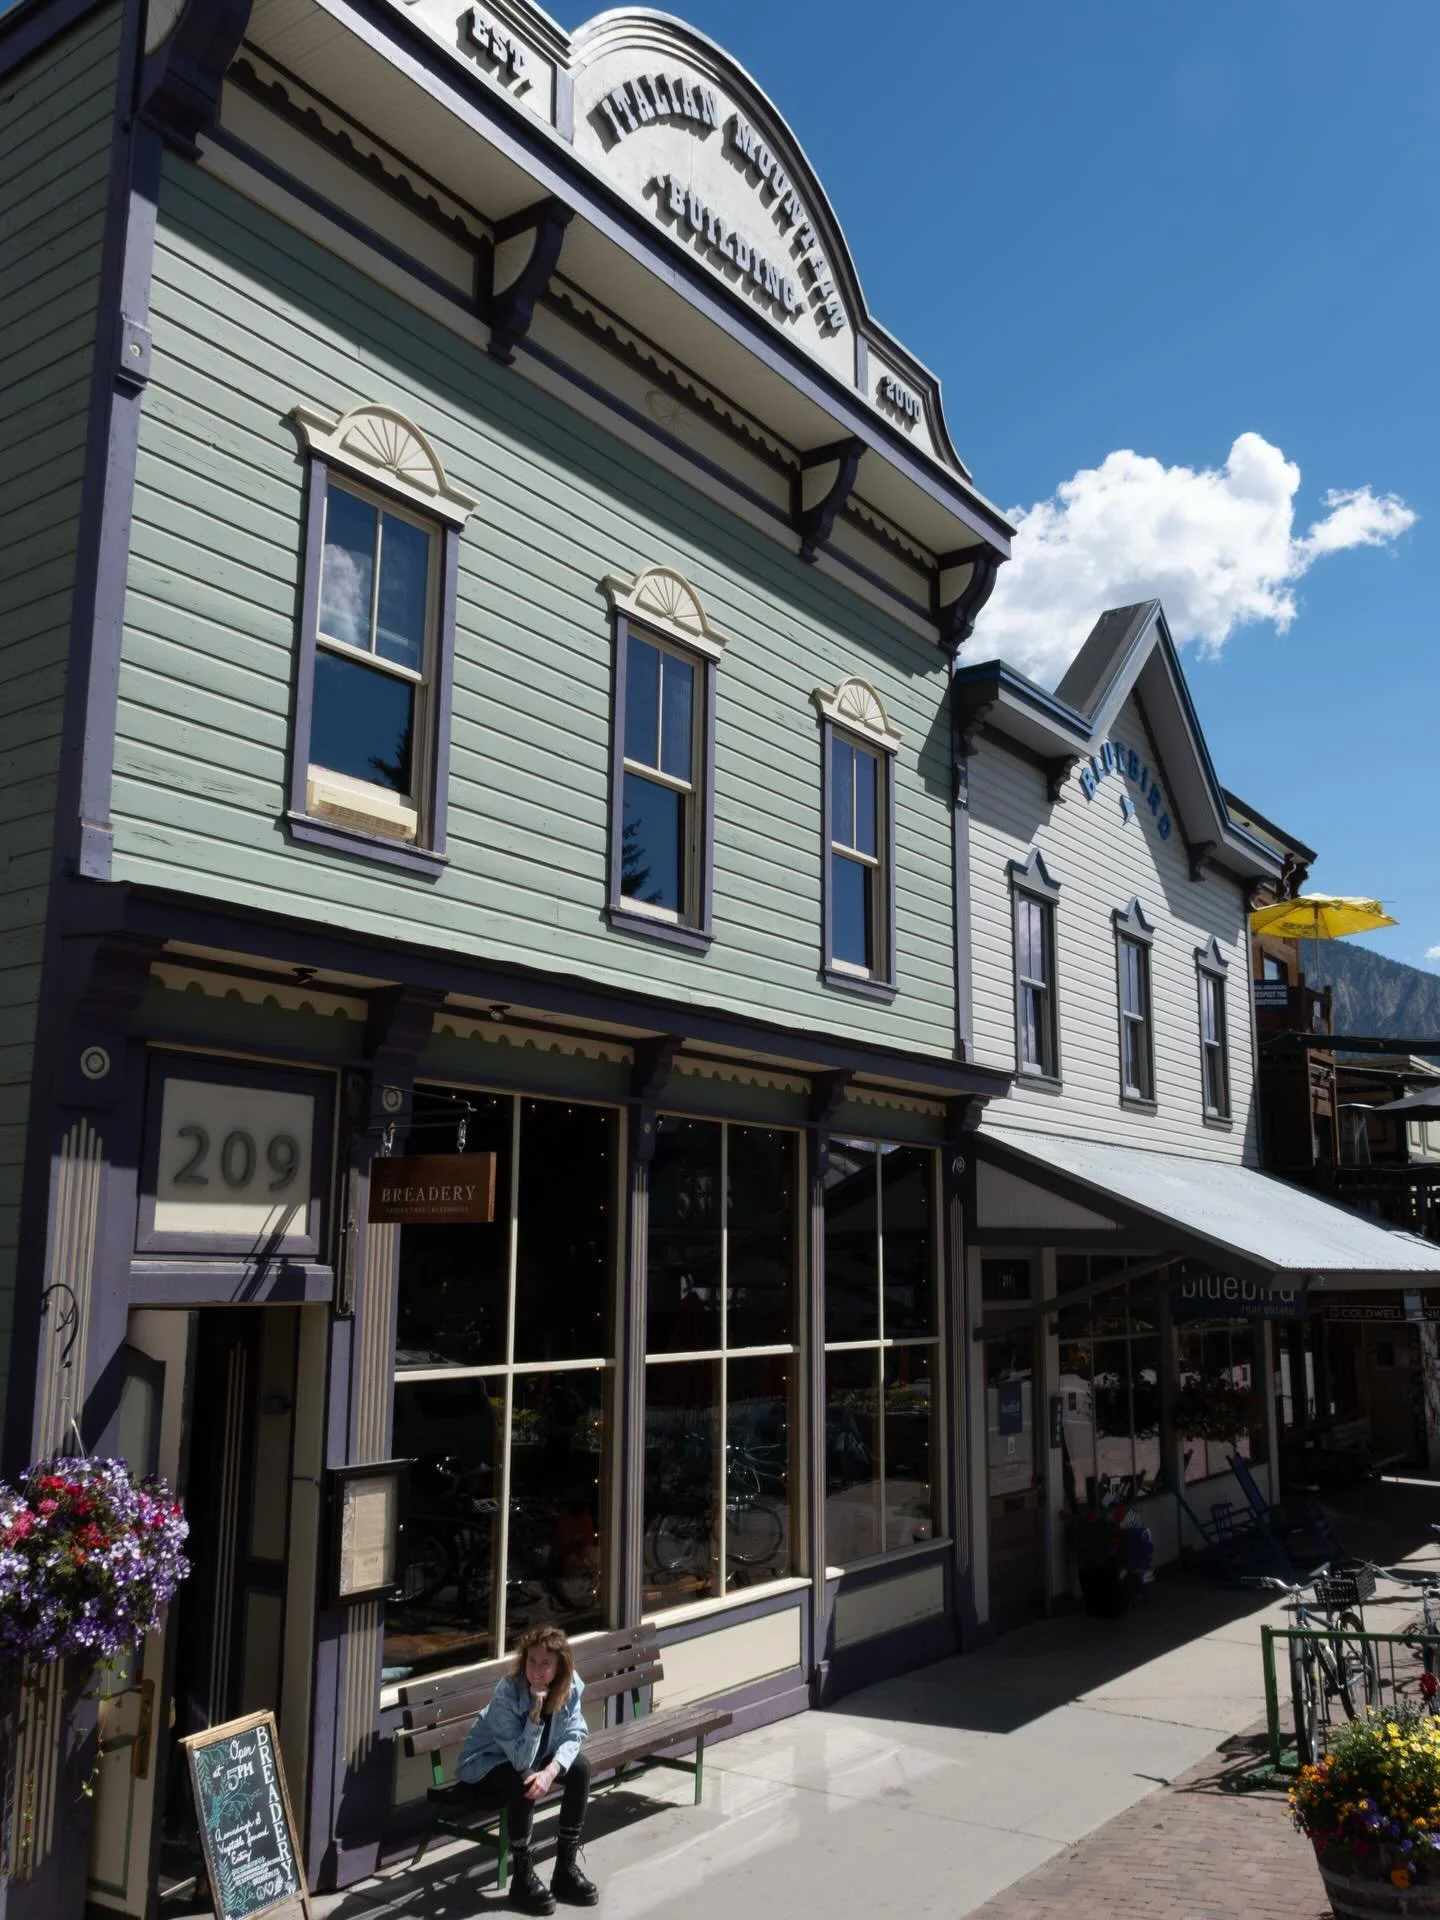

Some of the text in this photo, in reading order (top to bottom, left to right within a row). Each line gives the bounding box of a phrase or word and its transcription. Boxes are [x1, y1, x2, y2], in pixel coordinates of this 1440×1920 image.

[600, 72, 846, 329] ITALIAN MOUNTAIN
[885, 374, 921, 424] 2000
[1078, 738, 1171, 841] BLUEBIRD
[171, 1125, 299, 1191] 209
[381, 1185, 477, 1202] BREADERY
[226, 1761, 255, 1791] 5PM
[230, 1739, 256, 1763] Open
[256, 1726, 294, 1880] BREADERY
